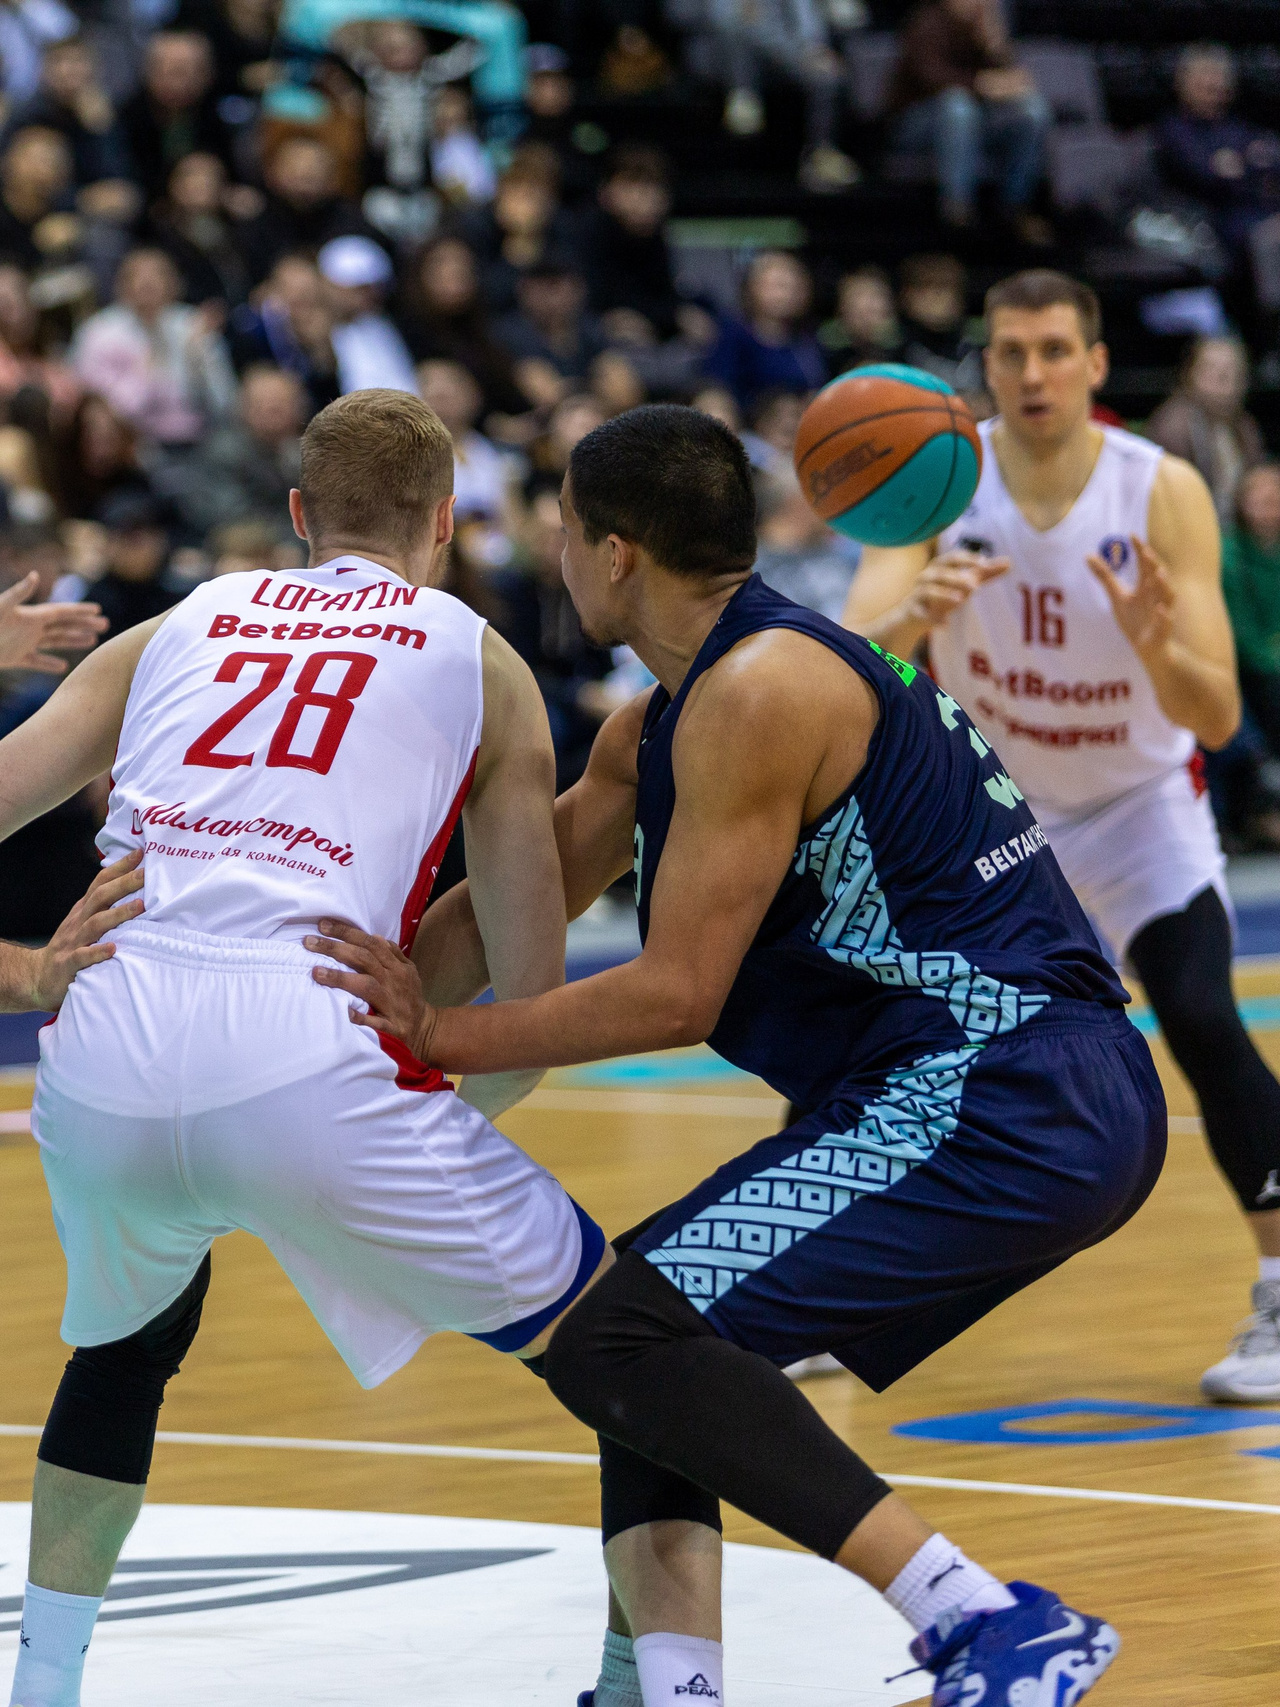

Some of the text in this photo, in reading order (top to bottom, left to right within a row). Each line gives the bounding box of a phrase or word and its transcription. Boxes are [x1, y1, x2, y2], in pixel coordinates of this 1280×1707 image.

[250, 577, 419, 612] LOPATIN
[206, 614, 427, 650] BetBoom
[1019, 581, 1065, 647] 16
[969, 651, 1131, 704] BtBoom
[182, 651, 378, 775] 28
[246, 850, 327, 878] компания
[674, 1685, 719, 1699] PEAK
